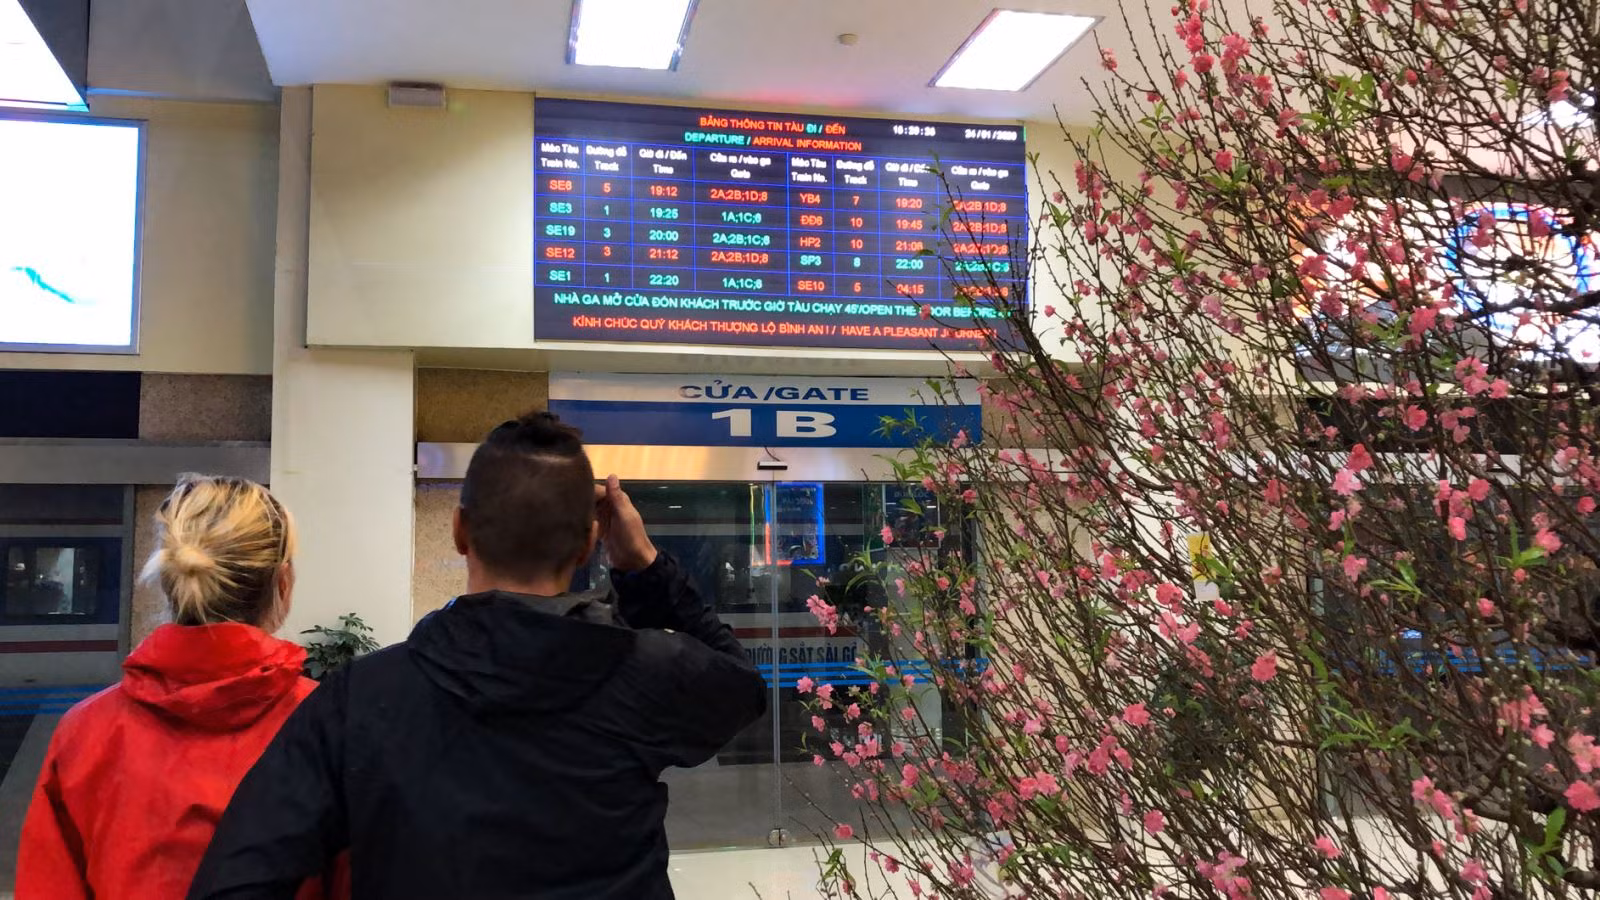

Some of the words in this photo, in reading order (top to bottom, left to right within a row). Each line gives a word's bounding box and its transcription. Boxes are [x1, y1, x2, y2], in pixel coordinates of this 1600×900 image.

[700, 115, 728, 127] BẢNG
[730, 119, 765, 130] THÔNG
[767, 122, 782, 130] TIN
[785, 121, 804, 131] TÀU
[685, 132, 744, 144] DEPARTURE
[753, 137, 793, 147] ARRIVAL
[797, 139, 861, 150] INFORMATION
[650, 186, 677, 196] 19:12
[800, 194, 820, 204] YB4
[853, 196, 860, 205] 7
[550, 203, 572, 213] SE3
[604, 205, 609, 215] 1
[850, 218, 863, 227] 10
[546, 225, 576, 236] SE19
[603, 227, 611, 238] 3
[649, 230, 679, 241] 20:00
[800, 237, 821, 248] HP2
[851, 239, 863, 249] 10
[546, 248, 575, 258] SE12
[604, 246, 611, 256] 3
[649, 249, 678, 259] 21:12
[800, 255, 821, 266] SP3
[896, 259, 923, 270] 22:00
[550, 271, 571, 281] SE1
[604, 272, 609, 282] 1
[649, 275, 679, 285] 22:20
[798, 281, 824, 291] SE10
[554, 292, 579, 304] NHÀ
[582, 294, 600, 305] GA
[681, 296, 719, 309] KHÁCH
[788, 300, 810, 313] TÀU
[812, 303, 842, 315] CHẠY
[896, 306, 917, 315] THE
[669, 319, 707, 331] KHÁCH
[842, 326, 871, 336] HAVE
[873, 326, 881, 336] A
[884, 327, 938, 338] PLEASANT
